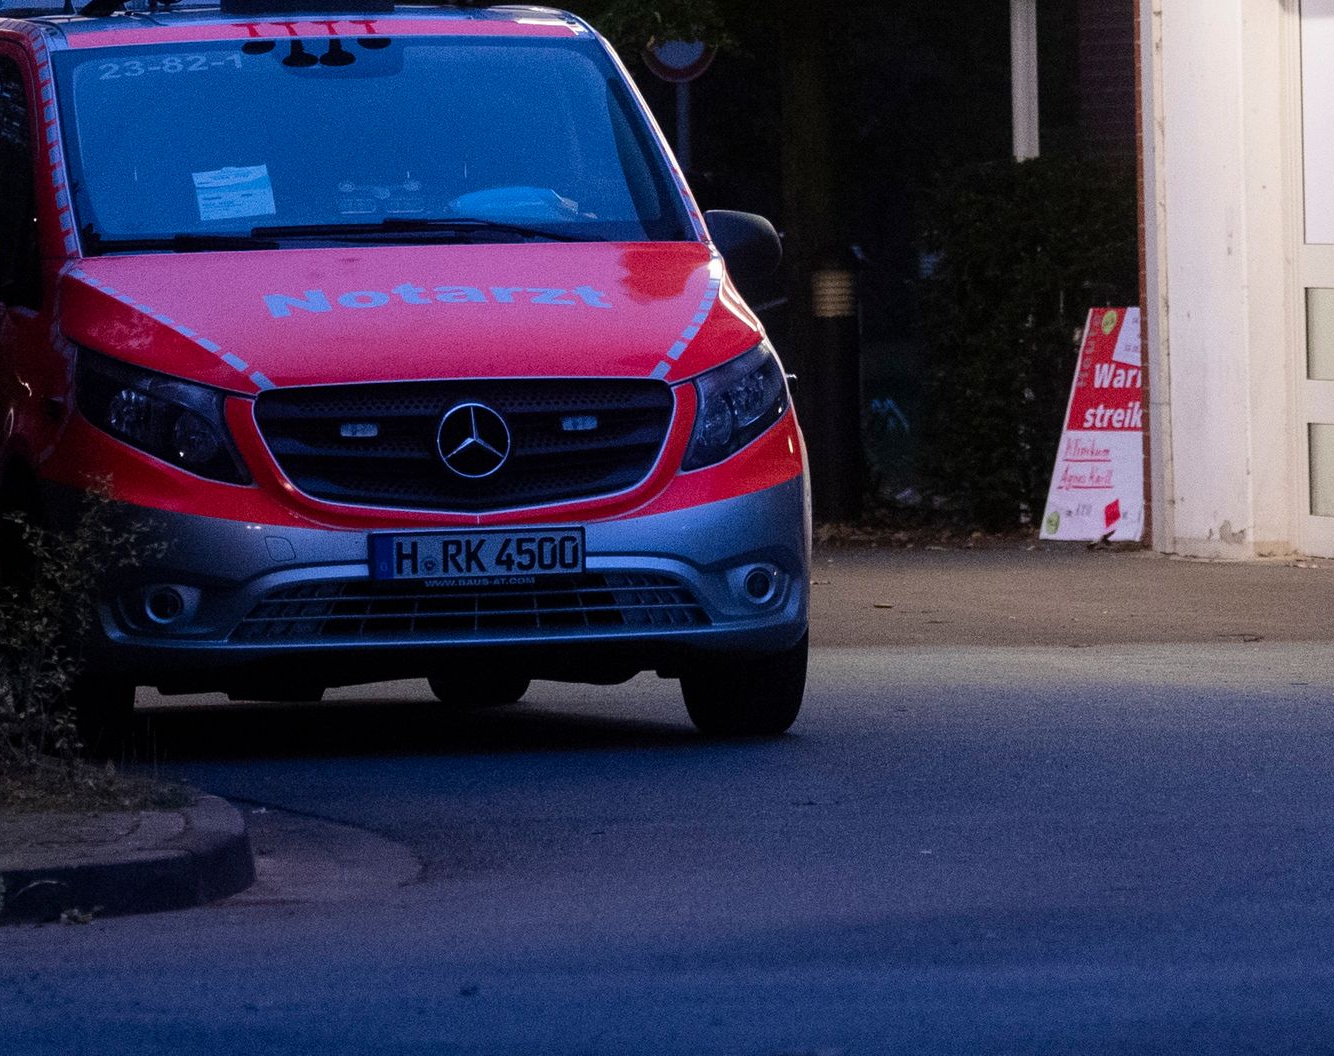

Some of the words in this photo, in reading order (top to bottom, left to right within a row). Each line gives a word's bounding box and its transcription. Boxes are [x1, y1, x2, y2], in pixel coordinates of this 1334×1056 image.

[97, 52, 243, 81] 23-82-1
[263, 280, 612, 318] Notarzt
[395, 540, 419, 575] H
[442, 538, 487, 574] RK
[494, 534, 580, 572] 4500
